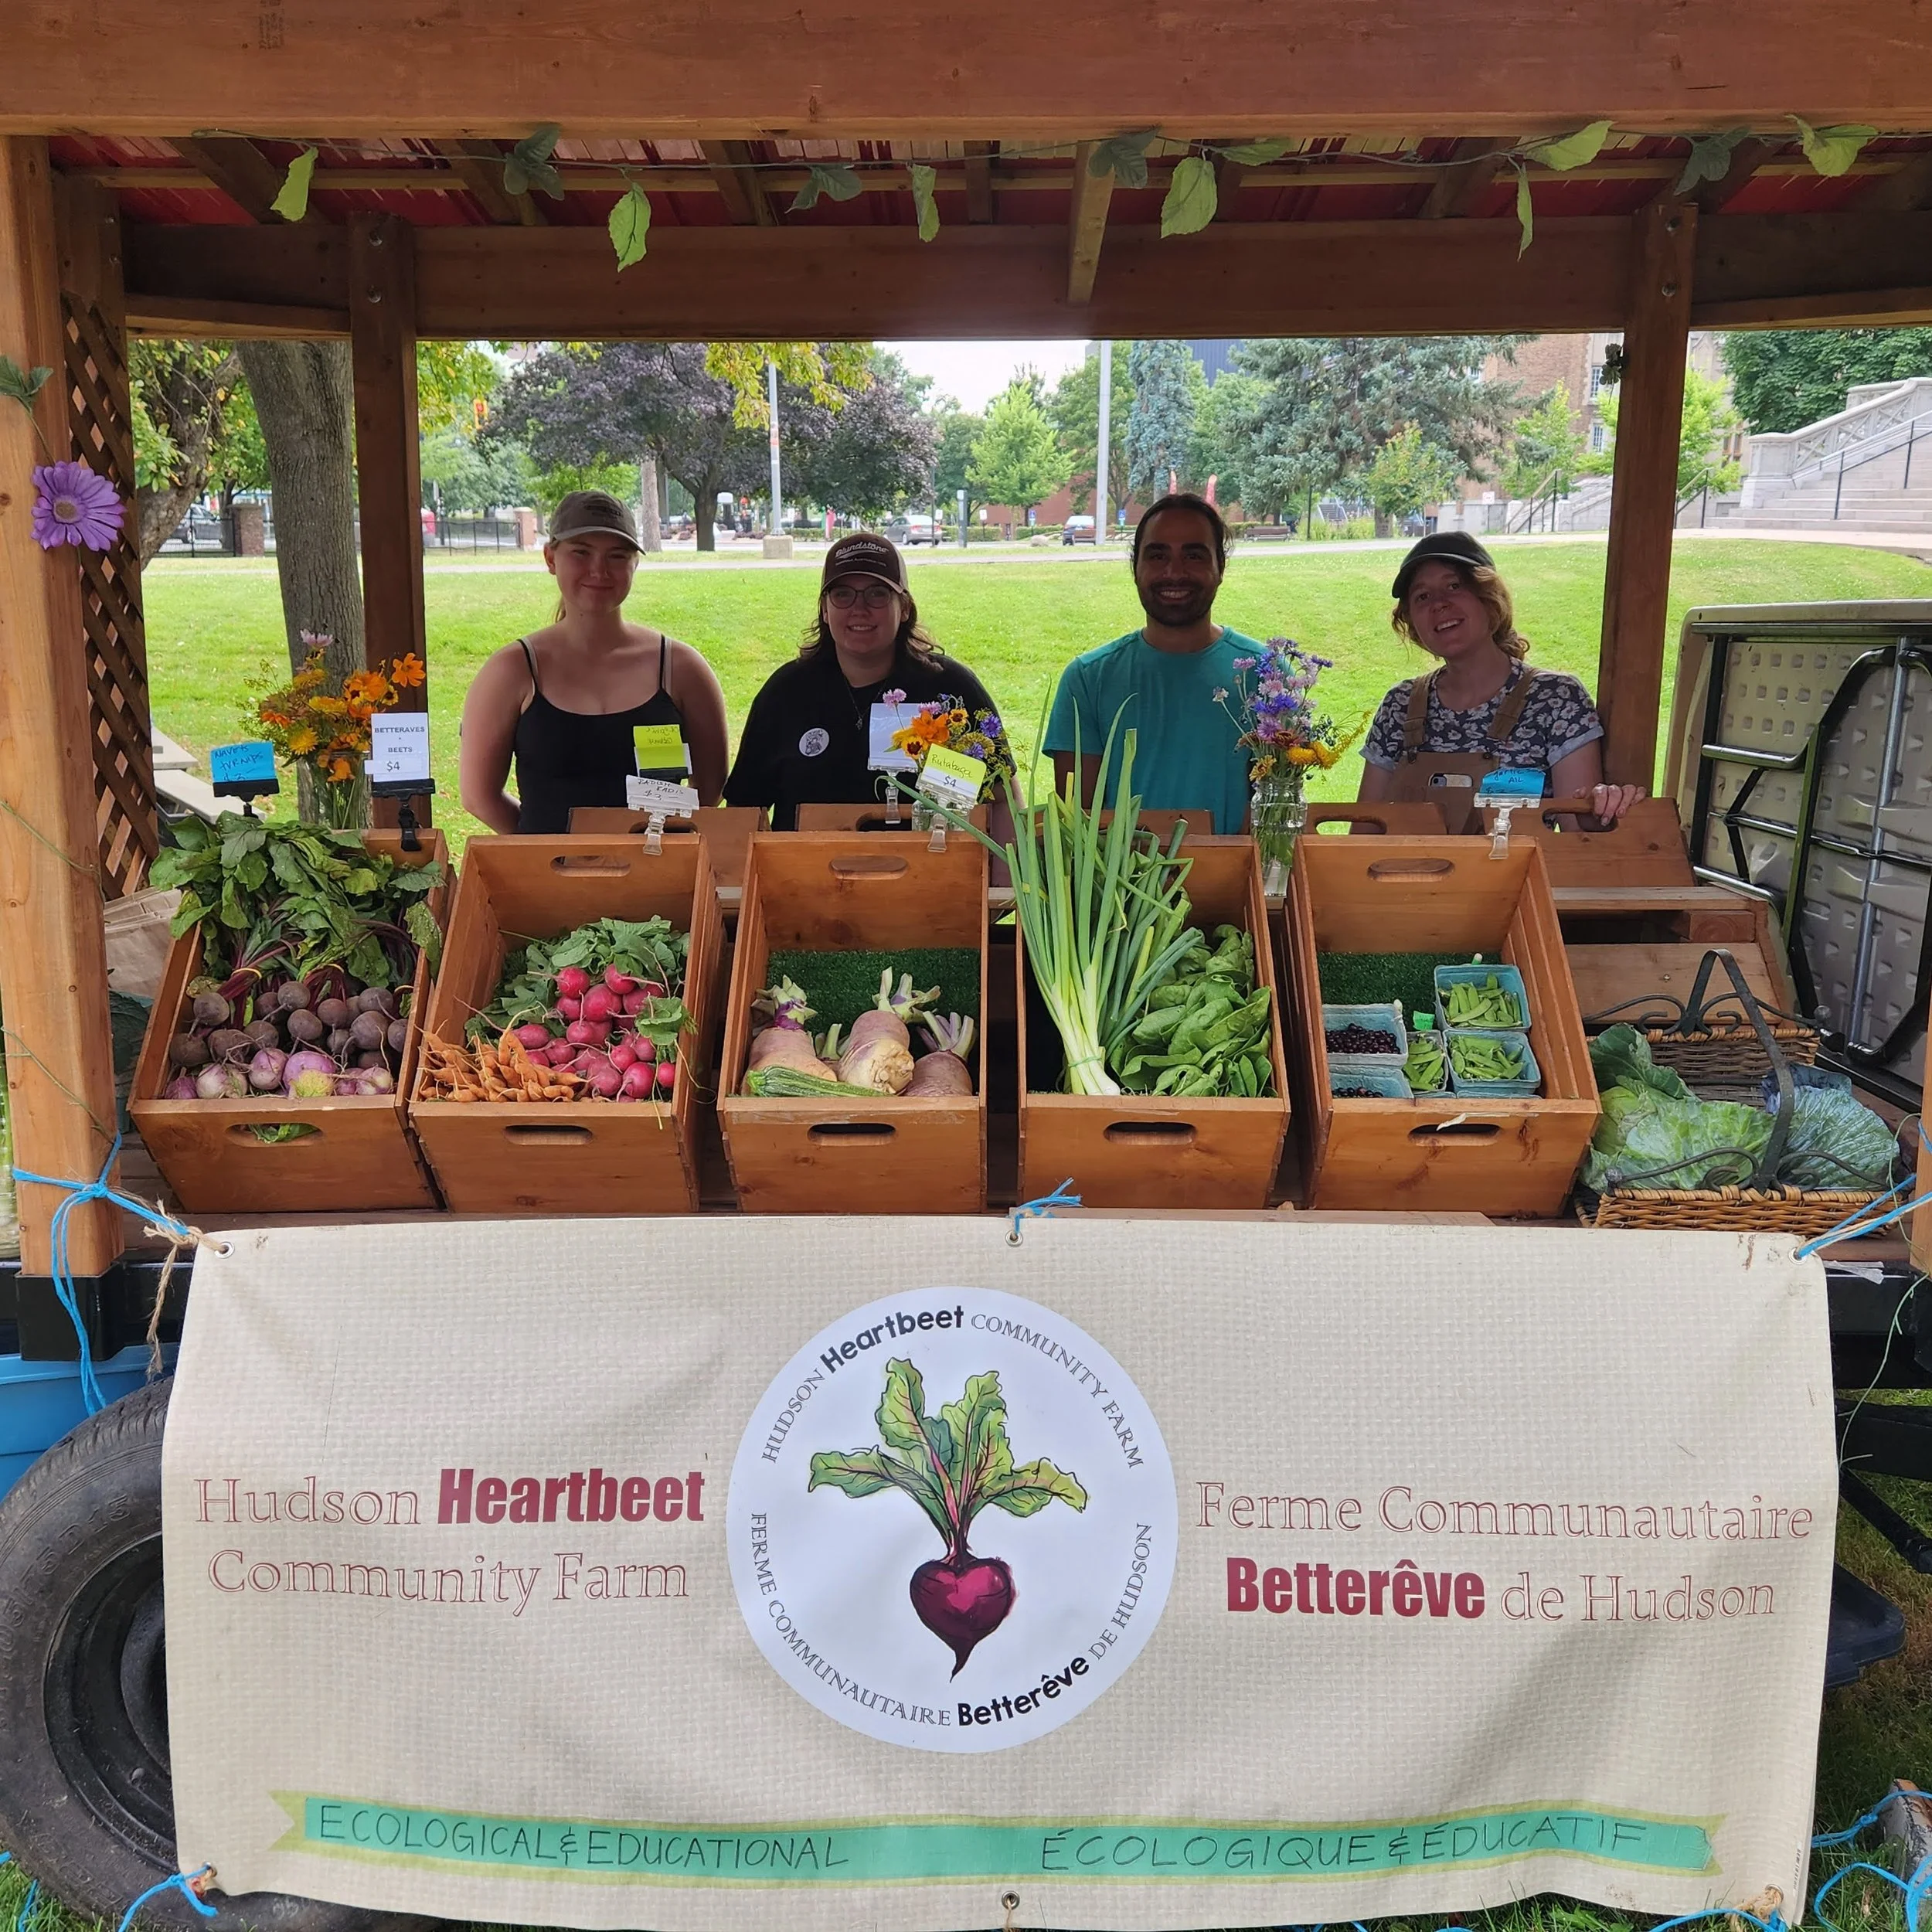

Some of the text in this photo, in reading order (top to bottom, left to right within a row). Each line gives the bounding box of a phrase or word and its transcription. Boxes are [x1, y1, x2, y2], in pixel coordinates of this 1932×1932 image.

[835, 542, 889, 557] Blundstone
[386, 760, 400, 772] $4
[931, 753, 973, 778] Rutabaga
[943, 775, 957, 788] $4
[762, 1305, 1144, 1469] HUDSON Heartbeet COMMUNITY FARM
[194, 1468, 705, 1525] Hudson Heartbeet
[1196, 1481, 1814, 1541] Ferme Communautaire
[208, 1549, 690, 1617] Community Farm
[1226, 1556, 1776, 1622] Betterêve de Hudson
[751, 1512, 1152, 1728] FERME COMMUNAUTAIRE Betterêve DE HUDSON
[1042, 1829, 1376, 1871] ÉCOLOGIQUE
